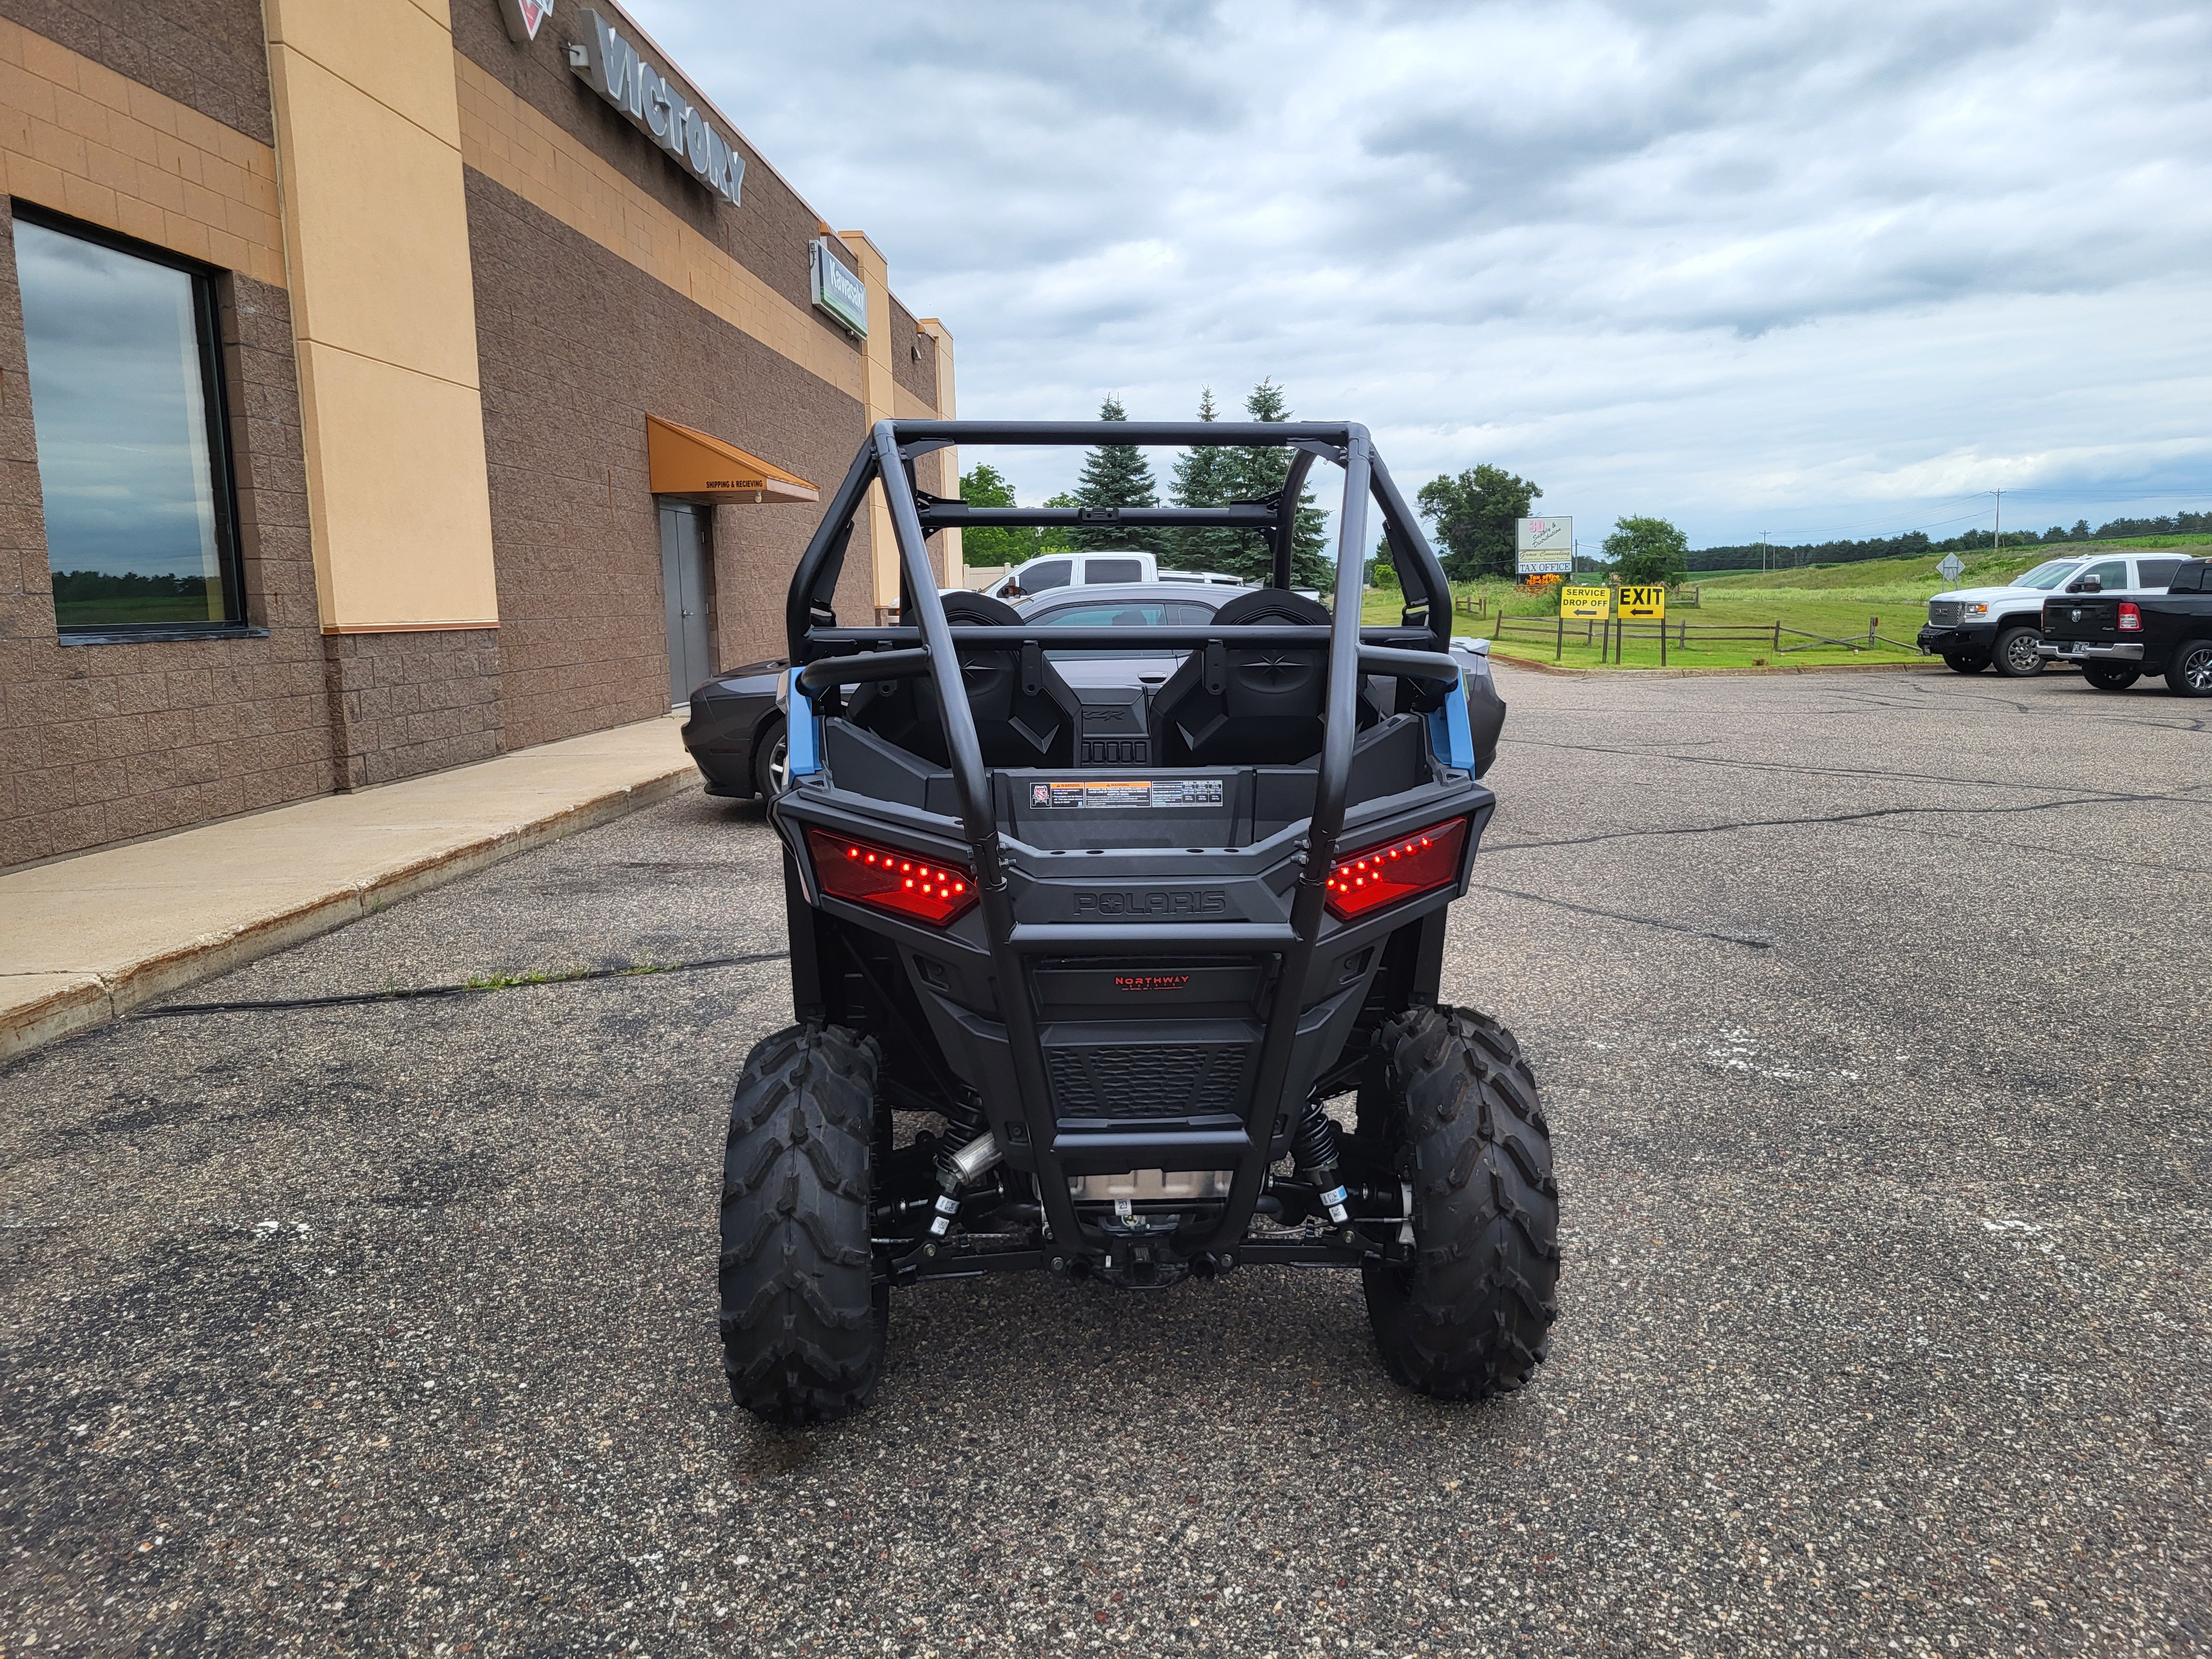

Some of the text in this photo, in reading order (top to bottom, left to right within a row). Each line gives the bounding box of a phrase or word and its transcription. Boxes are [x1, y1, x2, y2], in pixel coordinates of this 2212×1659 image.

[581, 8, 745, 207] VICTORY
[829, 258, 863, 312] Kawasaki
[1529, 521, 1545, 533] 3D
[1532, 527, 1551, 541] Supply
[1532, 528, 1561, 548] Distribution
[1519, 551, 1537, 560] Grace
[1566, 588, 1605, 597] SERVICE
[1620, 588, 1662, 605] EXIT
[1073, 891, 1225, 915] POLARIS
[1115, 976, 1189, 984] NORTHWAY
